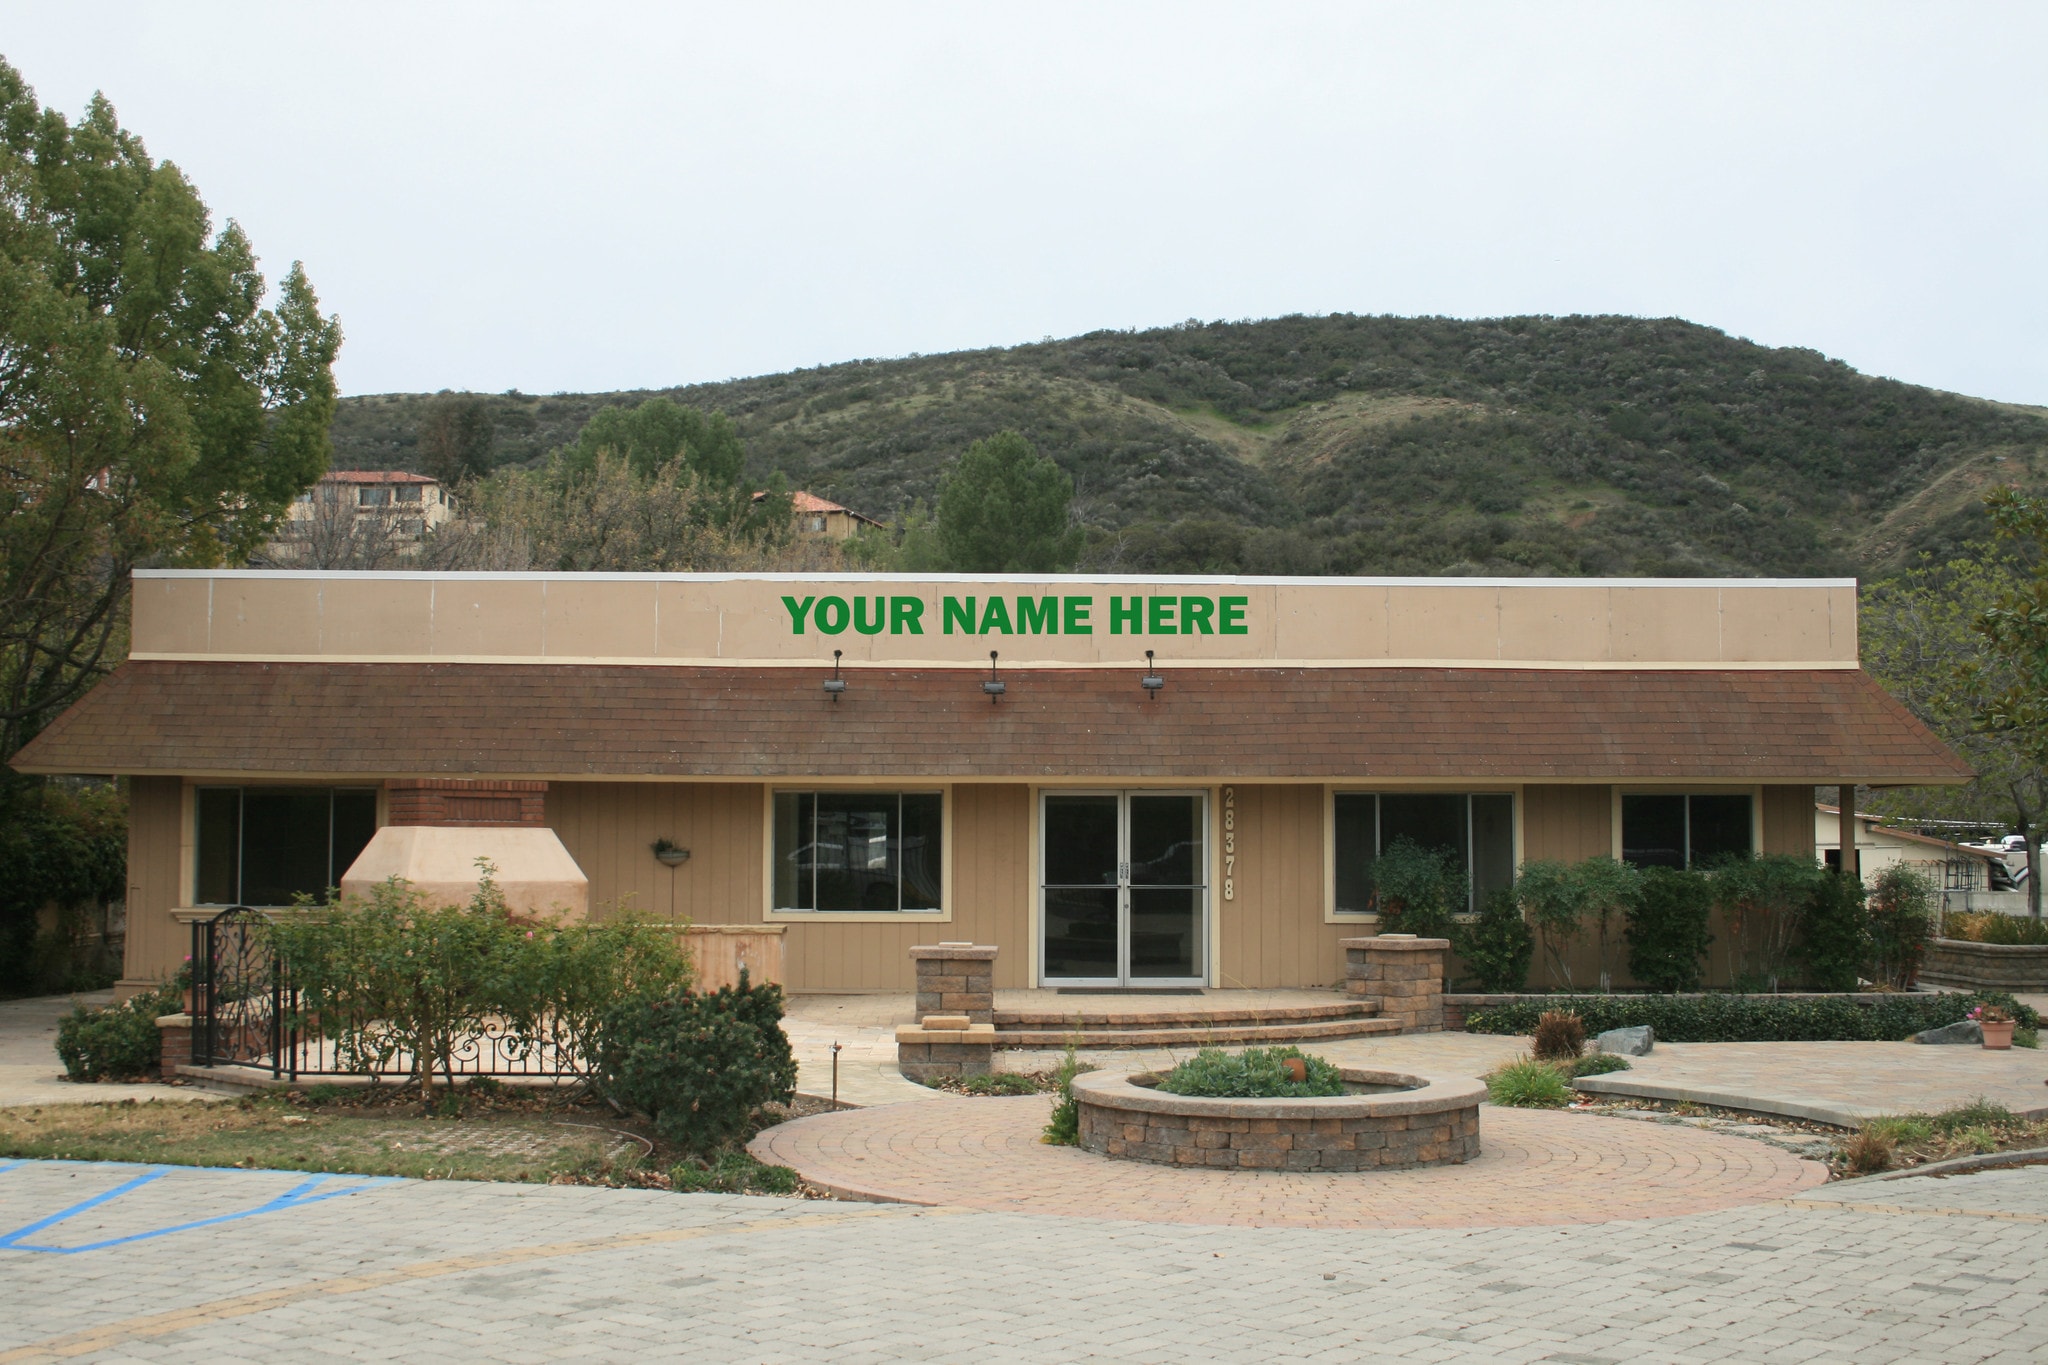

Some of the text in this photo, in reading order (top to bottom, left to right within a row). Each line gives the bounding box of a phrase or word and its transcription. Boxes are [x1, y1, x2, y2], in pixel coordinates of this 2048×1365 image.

[781, 596, 1249, 635] YOUR NAME HERE
[1225, 787, 1235, 900] 28378
